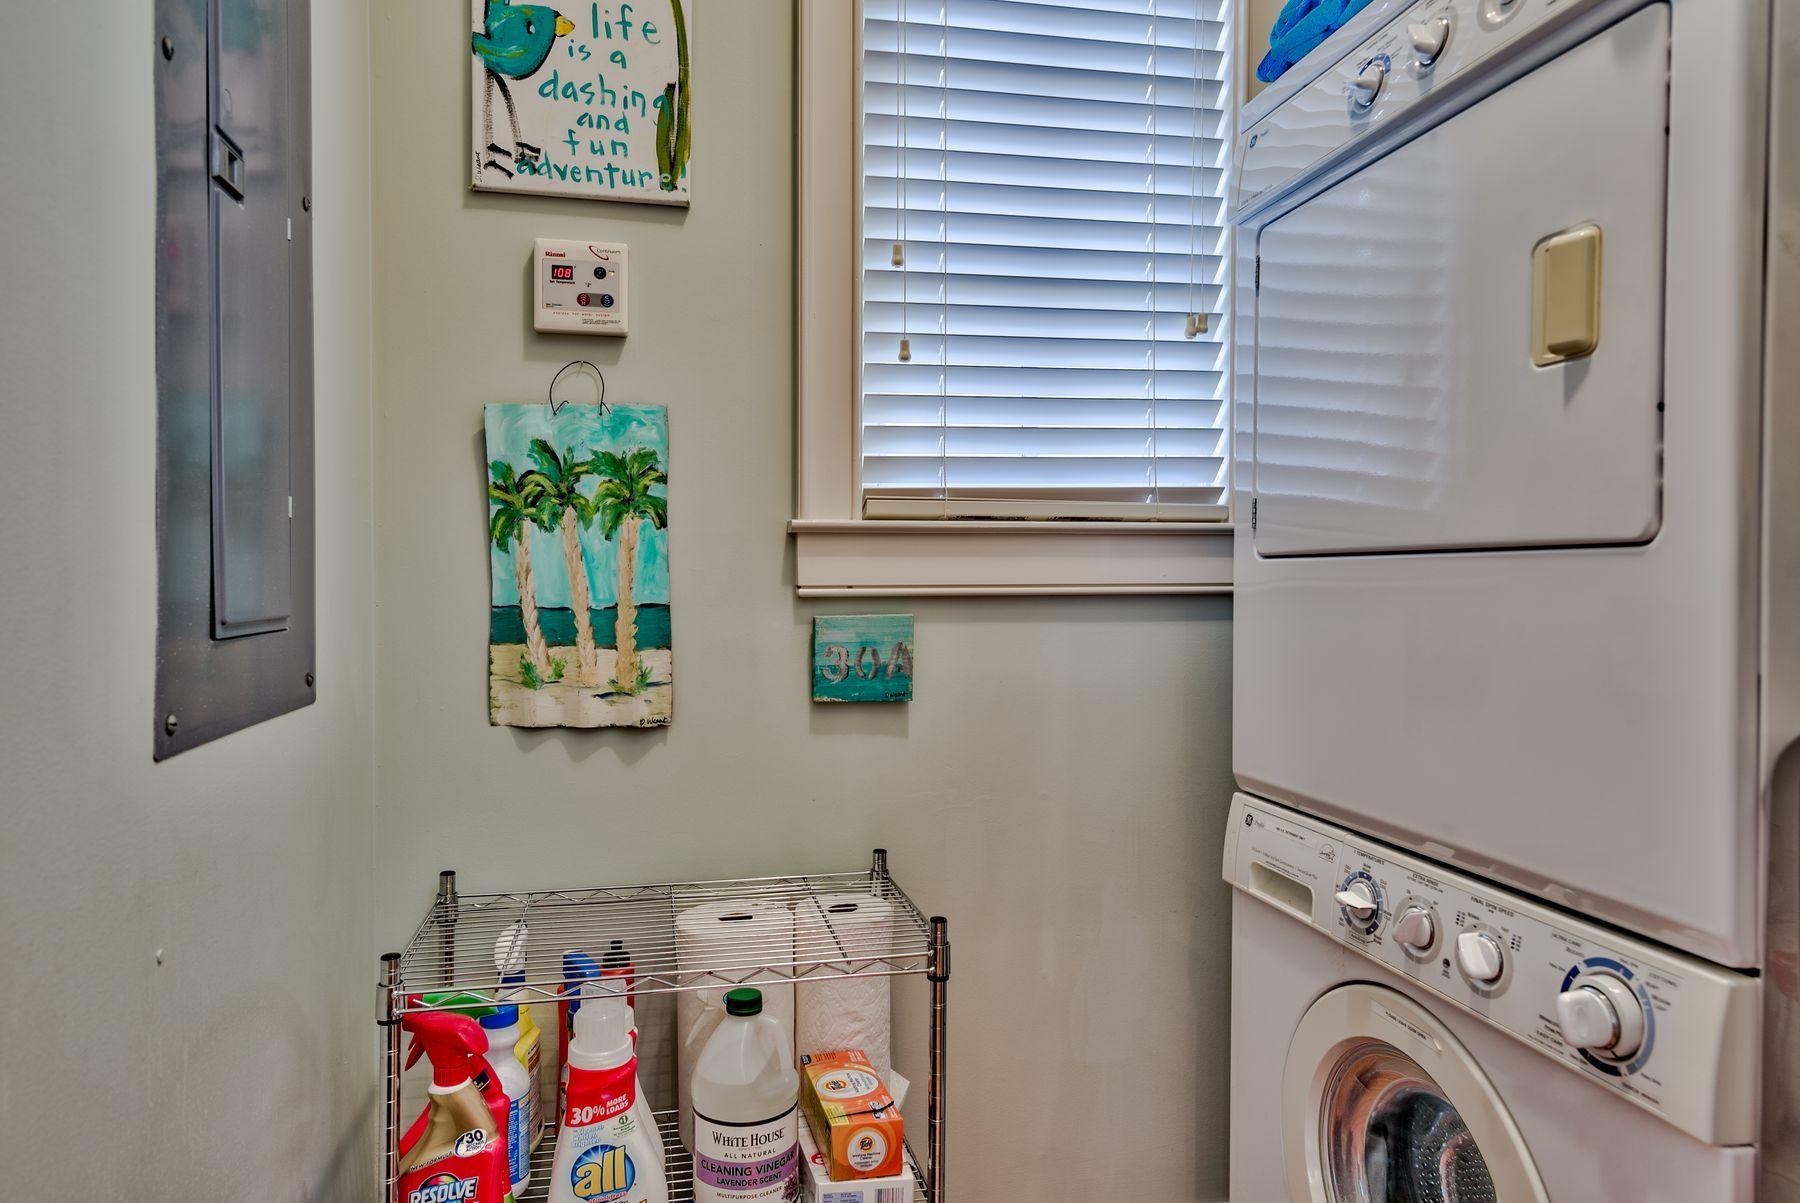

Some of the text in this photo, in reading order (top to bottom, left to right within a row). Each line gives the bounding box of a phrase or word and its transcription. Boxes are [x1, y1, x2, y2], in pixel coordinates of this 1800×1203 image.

[591, 2, 661, 44] life
[567, 39, 628, 69] is a
[538, 69, 670, 128] dashing
[576, 112, 630, 135] and
[562, 128, 629, 158] fun
[553, 267, 572, 278] 108
[822, 640, 914, 682] 30A
[570, 1100, 629, 1125] 30% LOADS
[605, 1093, 627, 1108] MORE
[465, 1130, 484, 1144] 30
[750, 1127, 785, 1147] HOUSE
[410, 1150, 453, 1171] NEW FORMULA
[701, 1151, 795, 1177] CLEANING VINEGAR
[741, 1148, 776, 1159] NATURAL
[573, 1145, 628, 1198] all
[716, 1171, 782, 1187] LAVENDER SCENT
[410, 1177, 477, 1203] RESOLVE
[716, 1186, 783, 1200] MULTIPURPOSE CLEANER
